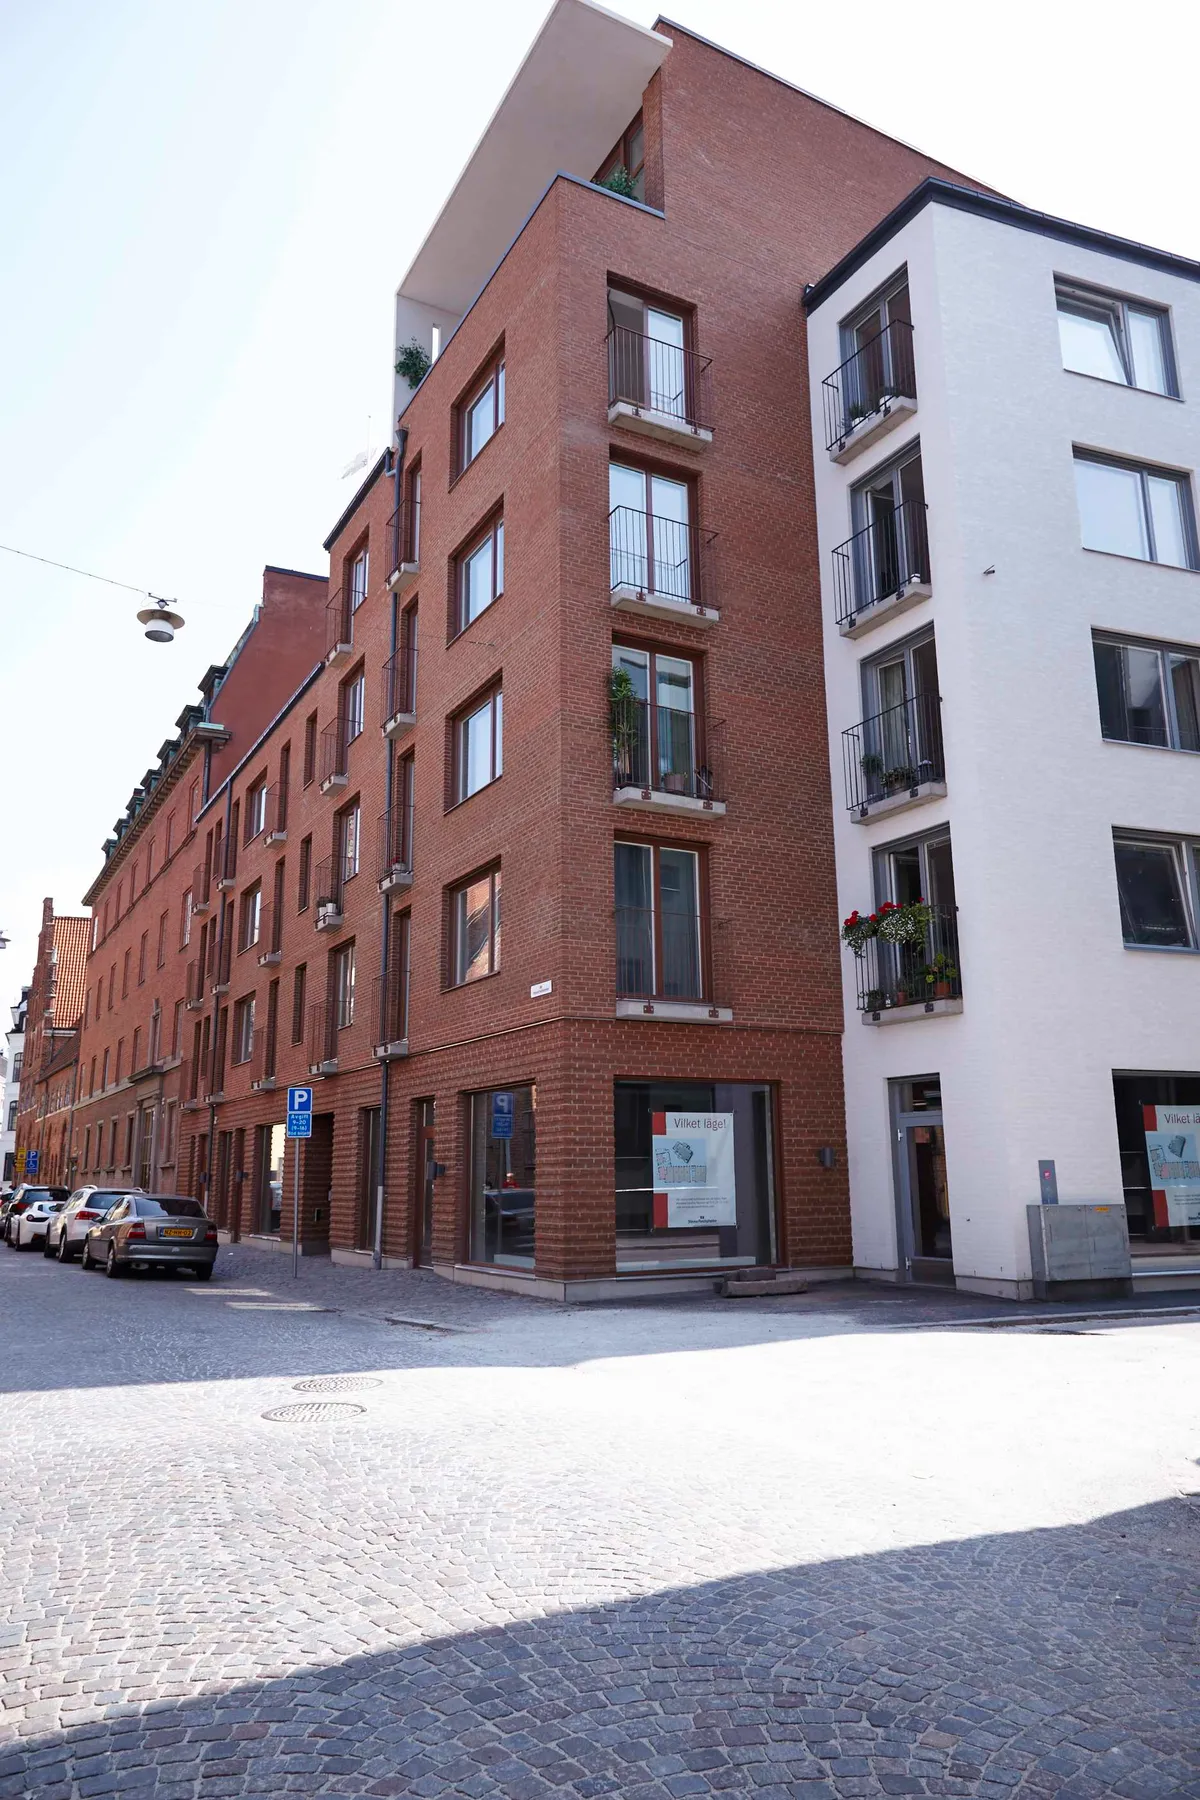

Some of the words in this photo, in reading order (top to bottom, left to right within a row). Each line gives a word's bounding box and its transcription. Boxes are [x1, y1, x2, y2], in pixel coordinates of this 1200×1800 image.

[294, 1090, 308, 1110] P
[673, 1118, 701, 1129] Vilket
[703, 1118, 727, 1131] läge!
[1163, 1112, 1190, 1124] Vilket
